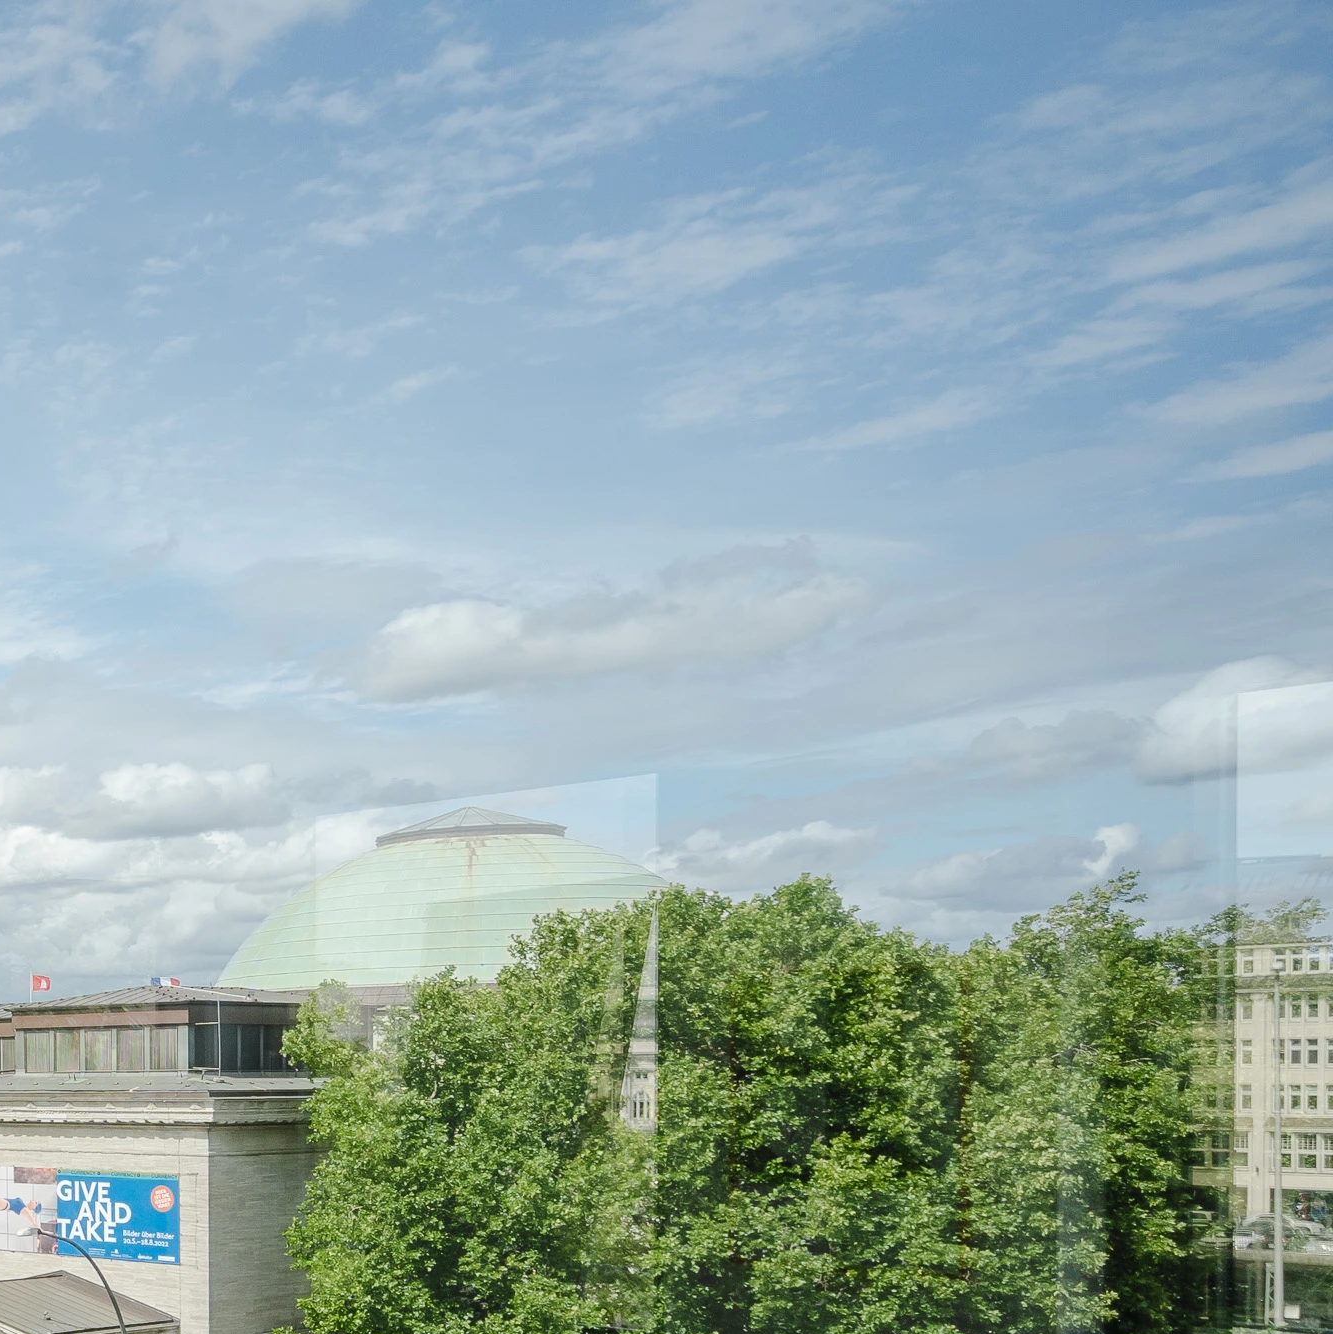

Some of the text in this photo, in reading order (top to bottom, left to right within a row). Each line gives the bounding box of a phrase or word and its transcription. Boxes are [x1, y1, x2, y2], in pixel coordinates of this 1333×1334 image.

[56, 1179, 111, 1203] GIVE
[77, 1200, 132, 1224] AND
[56, 1218, 117, 1243] TAKE
[122, 1229, 141, 1237] Bilder
[156, 1232, 175, 1240] Bilder
